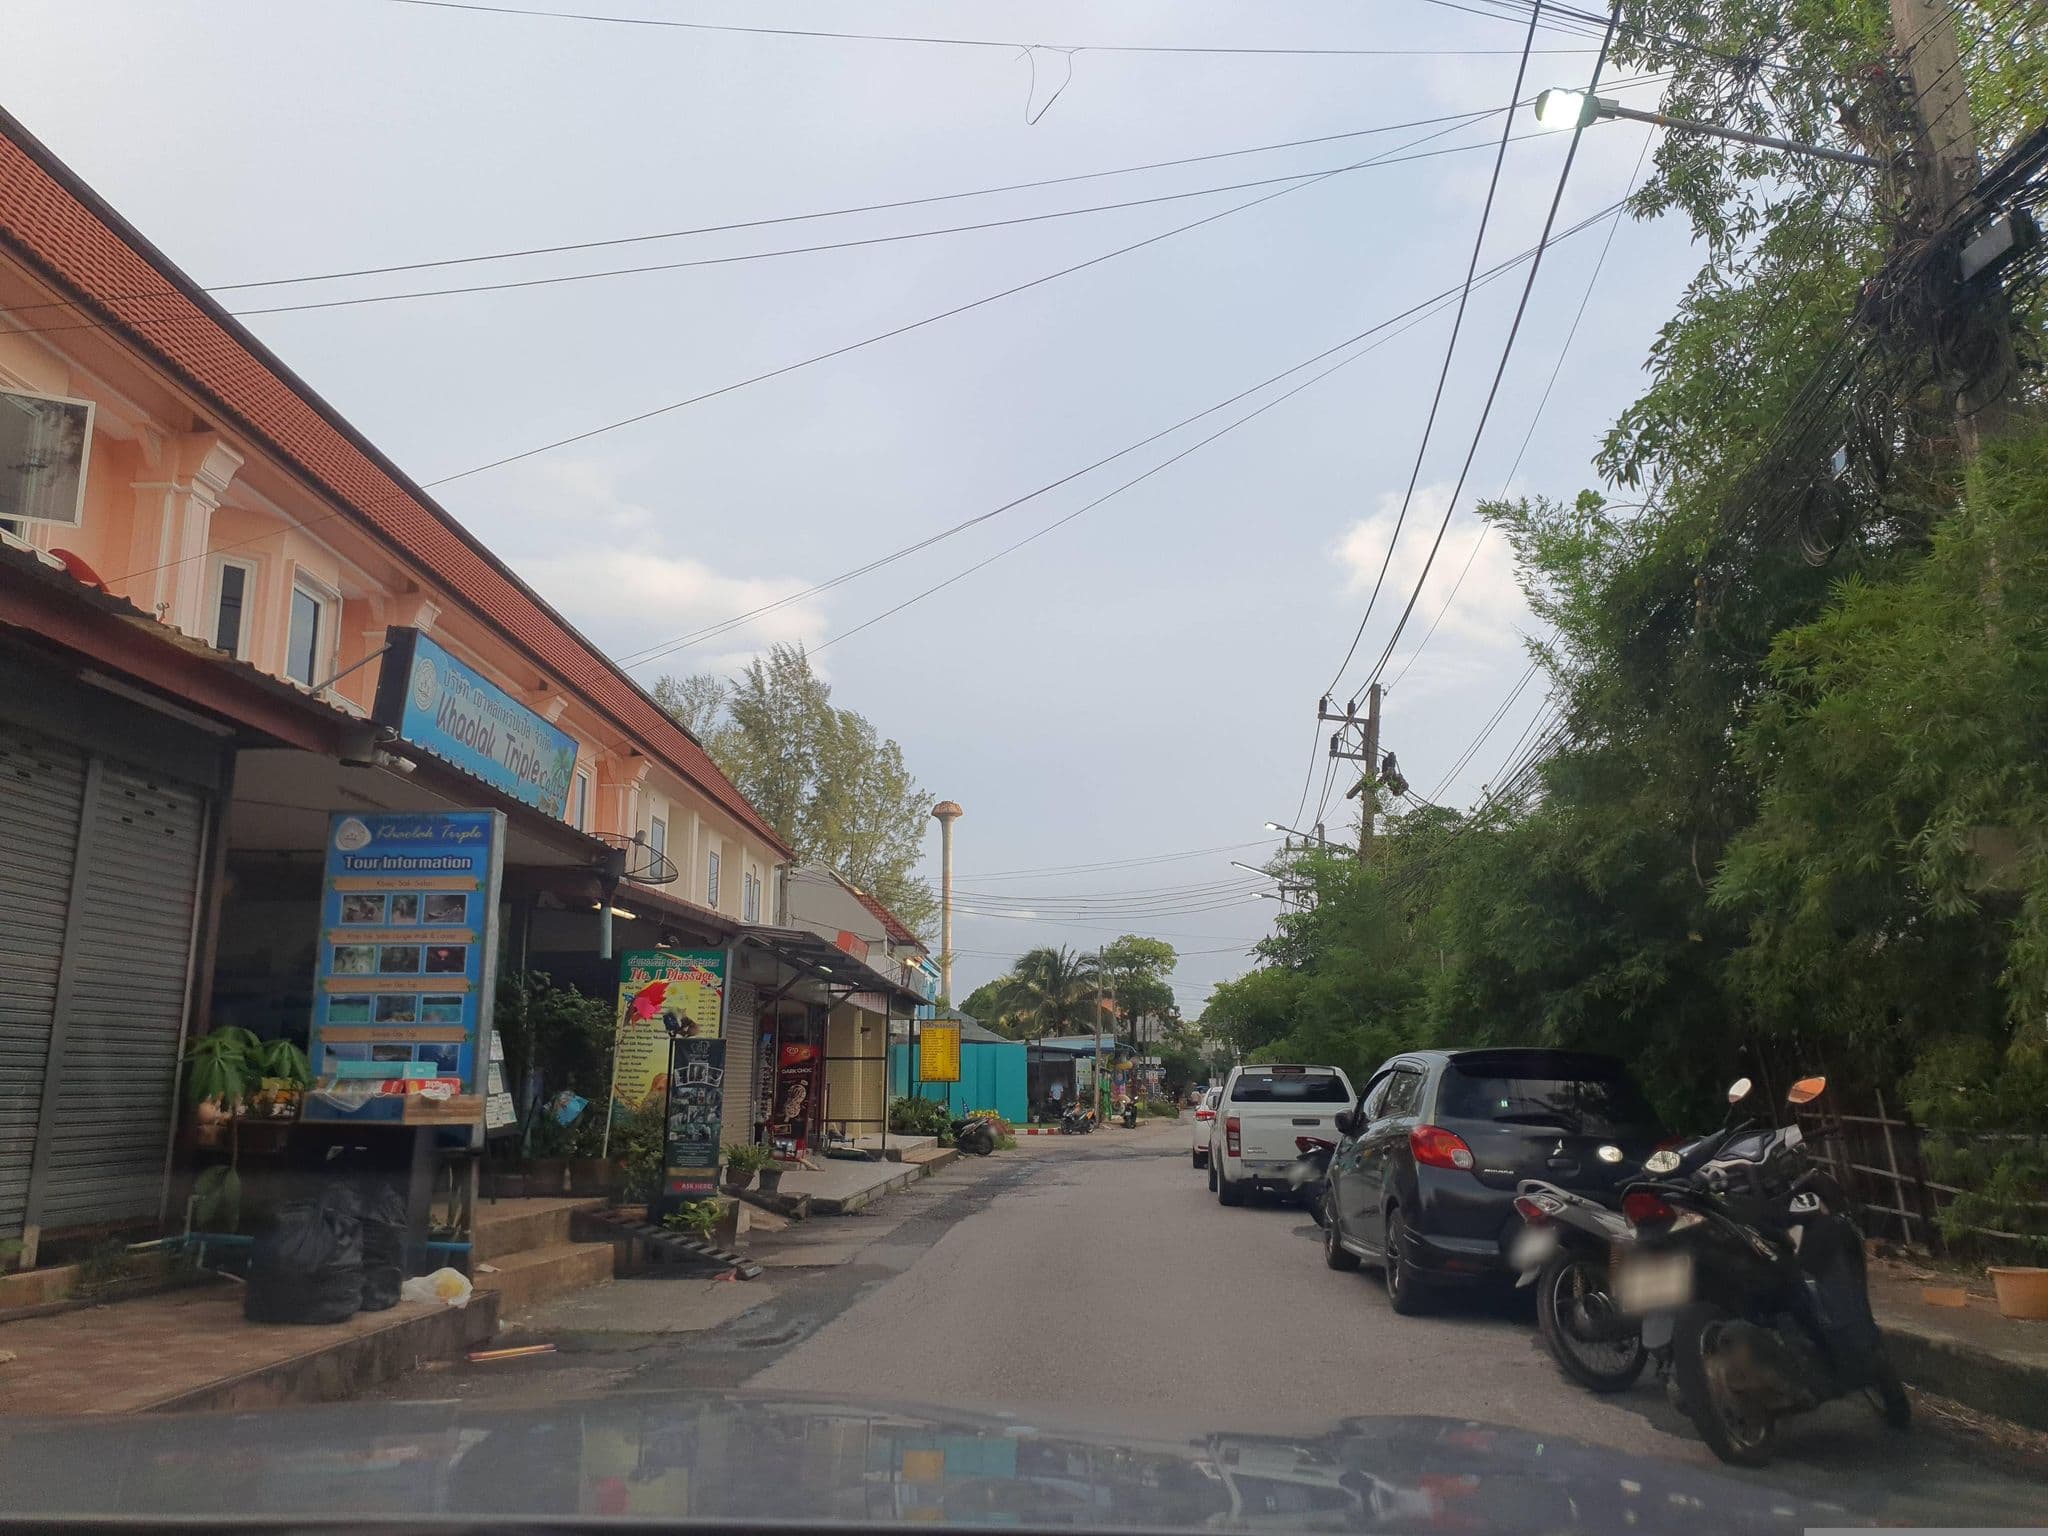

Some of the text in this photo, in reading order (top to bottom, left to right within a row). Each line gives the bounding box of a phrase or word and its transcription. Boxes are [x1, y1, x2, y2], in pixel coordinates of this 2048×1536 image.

[436, 691, 496, 760] Khaolak
[503, 732, 540, 787] Triple
[376, 824, 483, 844] Khaolak Triple
[344, 854, 472, 870] Tour Information
[666, 967, 717, 985] Massage
